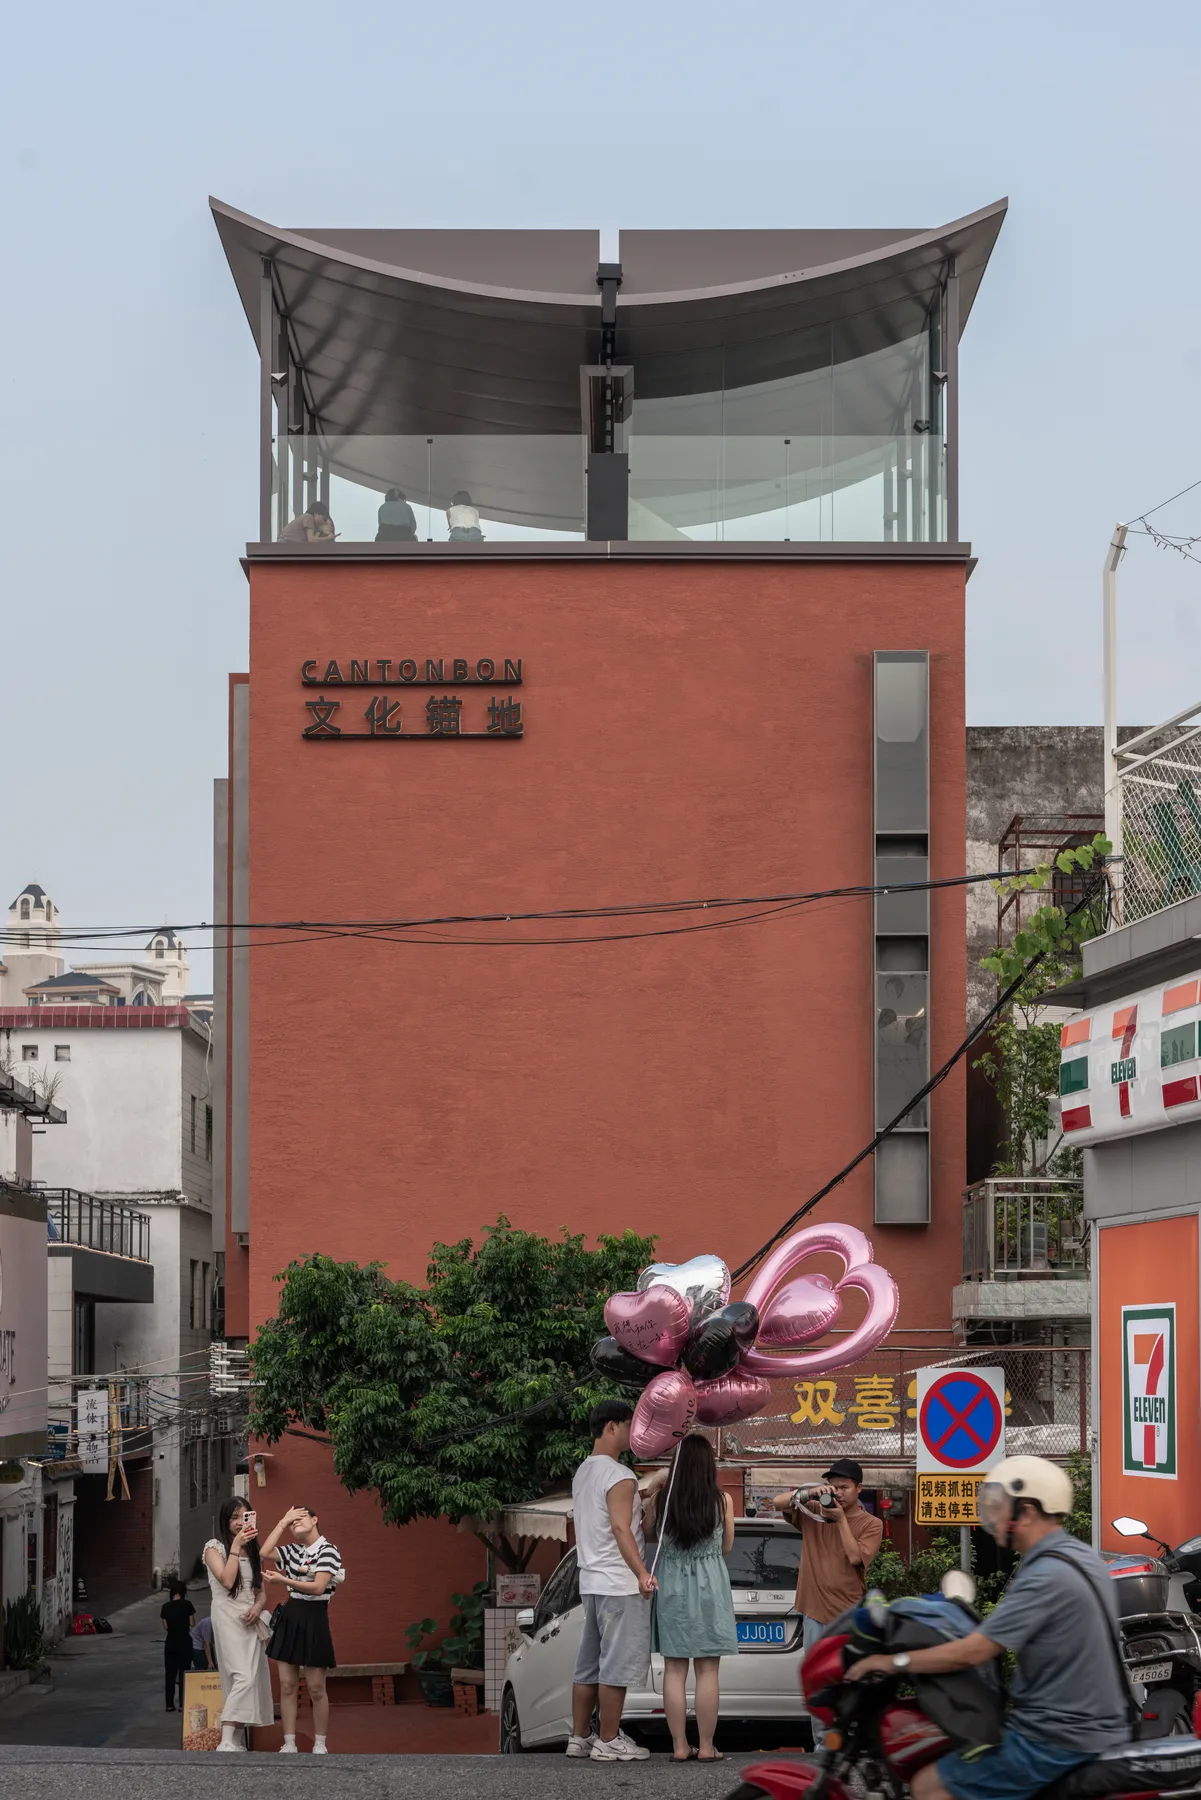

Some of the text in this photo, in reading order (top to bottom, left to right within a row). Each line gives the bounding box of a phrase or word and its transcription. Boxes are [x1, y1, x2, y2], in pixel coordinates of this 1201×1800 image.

[302, 659, 522, 682] CANTONBON
[304, 696, 523, 735] 文化锚地
[921, 1501, 981, 1518] 请违停车
[1132, 1669, 1170, 1683] E45065
